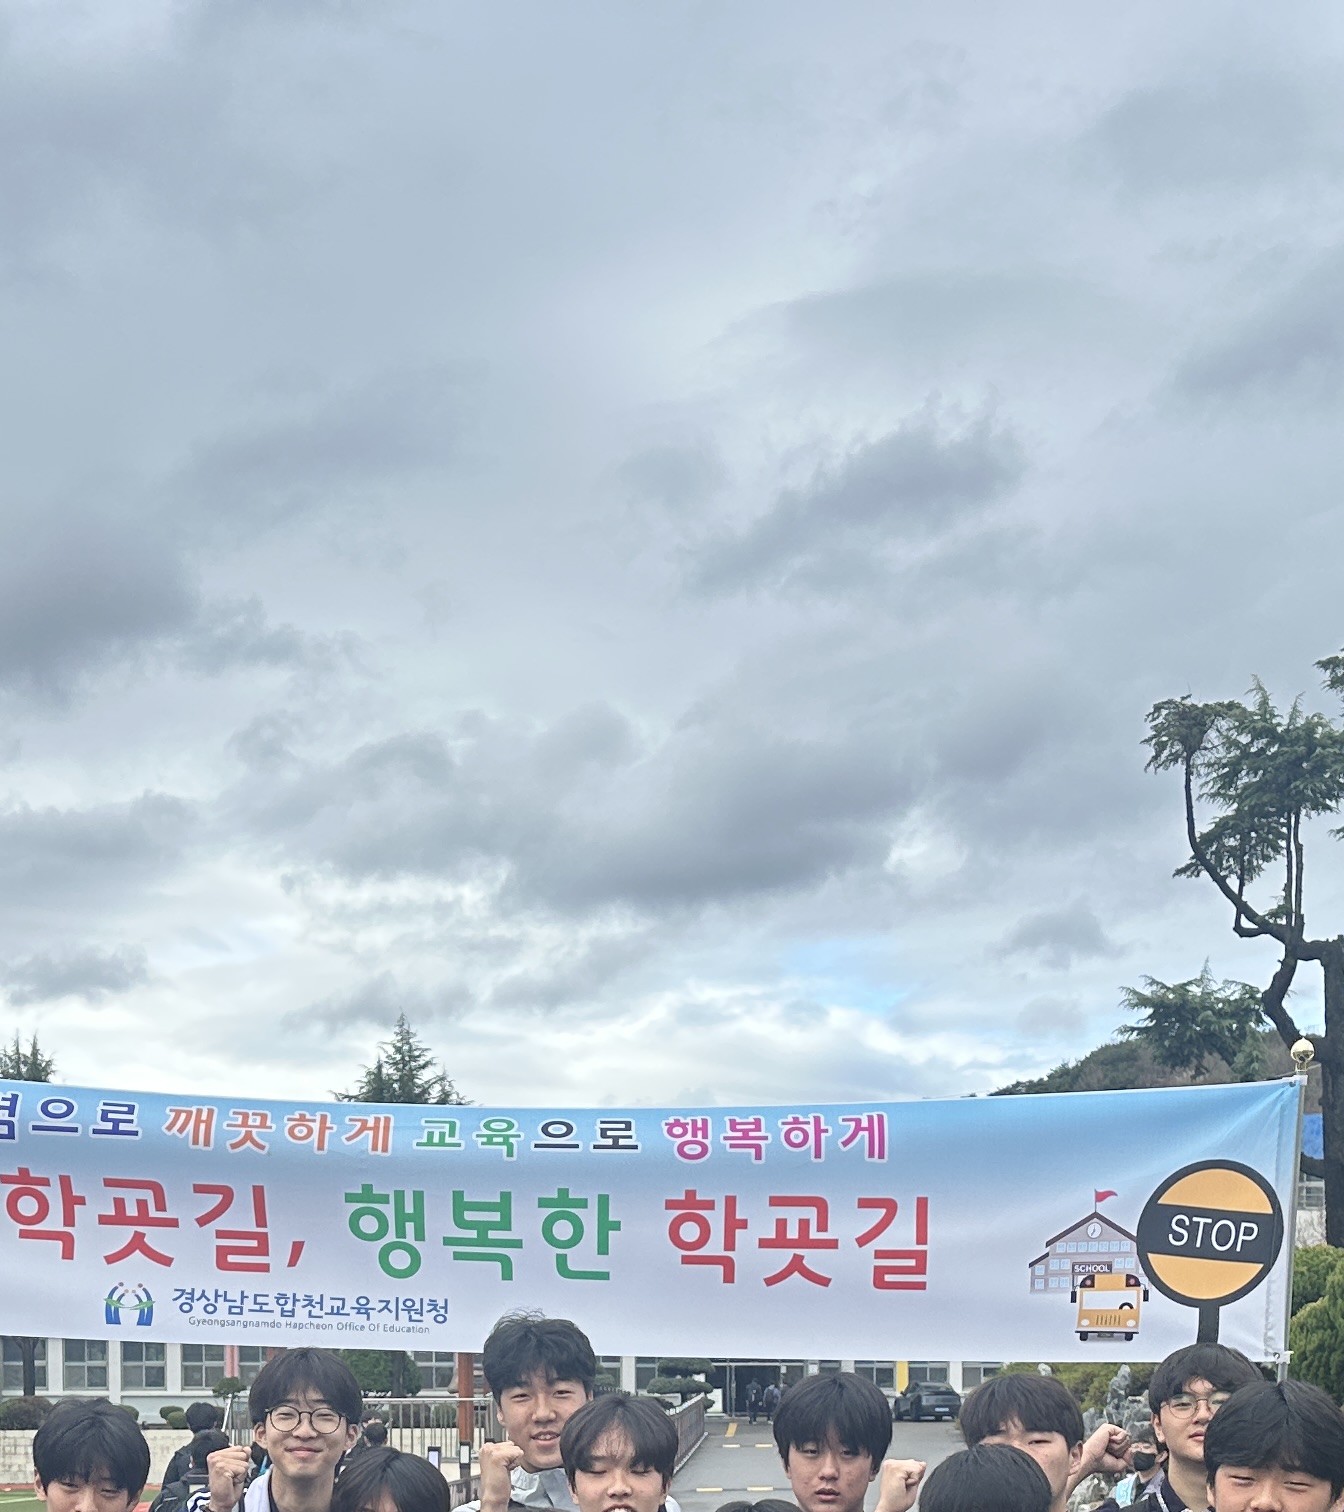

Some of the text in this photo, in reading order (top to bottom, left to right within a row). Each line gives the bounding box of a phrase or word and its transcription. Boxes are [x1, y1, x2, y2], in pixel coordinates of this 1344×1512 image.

[165, 1106, 393, 1154] 깨끗하게
[415, 1117, 640, 1158] 교육으로
[665, 1113, 888, 1162] 행복하게
[345, 1184, 622, 1281] 행복한
[665, 1189, 929, 1291] 학굣길
[1167, 1213, 1258, 1253] STOP
[1074, 1264, 1111, 1273] SCHOOL
[172, 1287, 449, 1325] 경상남도합천교육지원청
[188, 1316, 431, 1334] Gyeongsangnamdo Hapcheon Office Of Education
